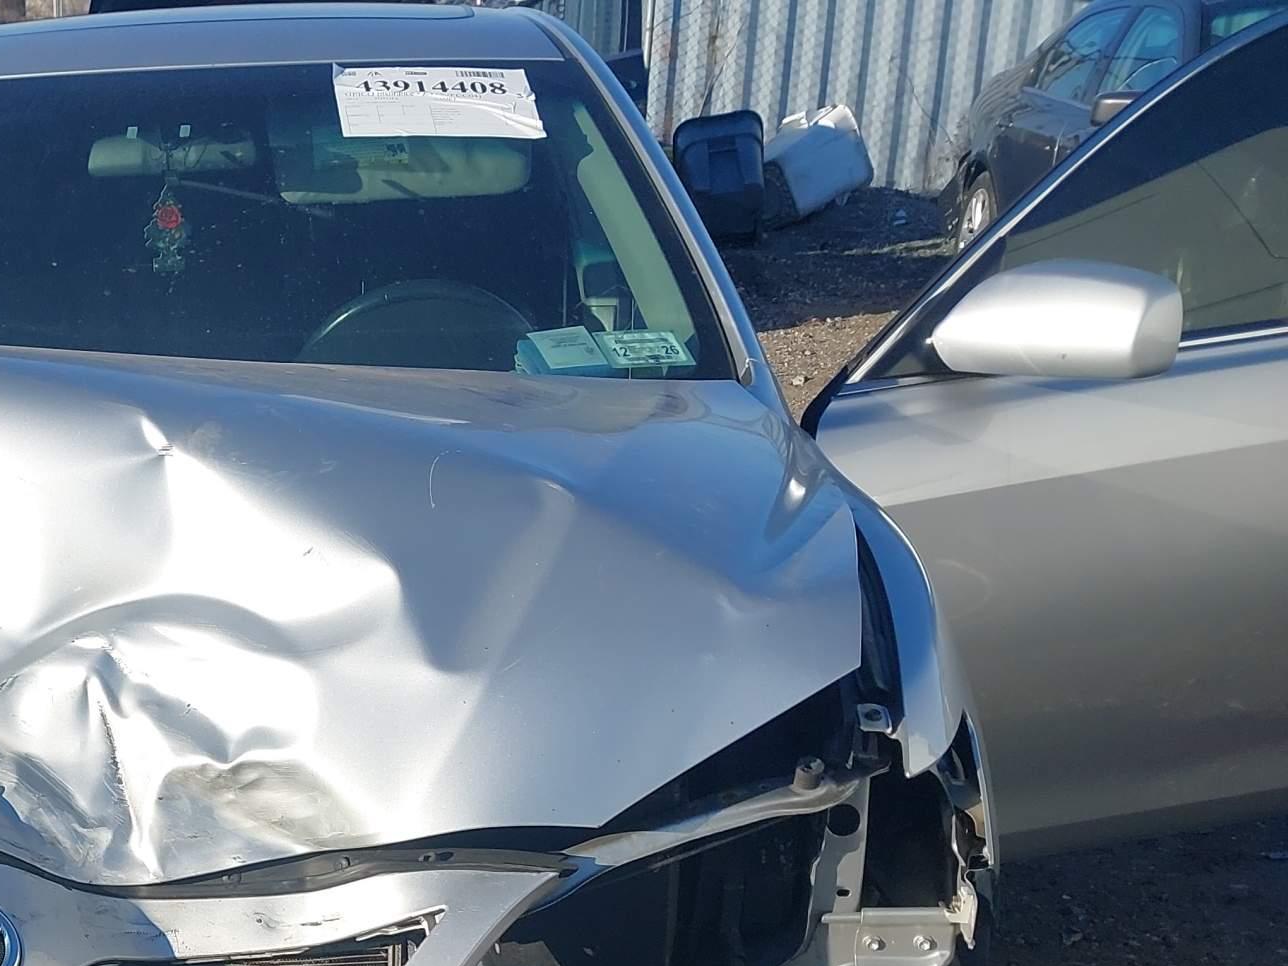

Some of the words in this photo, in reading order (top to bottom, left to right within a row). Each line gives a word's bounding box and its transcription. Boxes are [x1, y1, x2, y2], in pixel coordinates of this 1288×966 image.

[356, 79, 508, 95] 43914408
[613, 346, 631, 357] 12
[661, 345, 680, 355] 26
